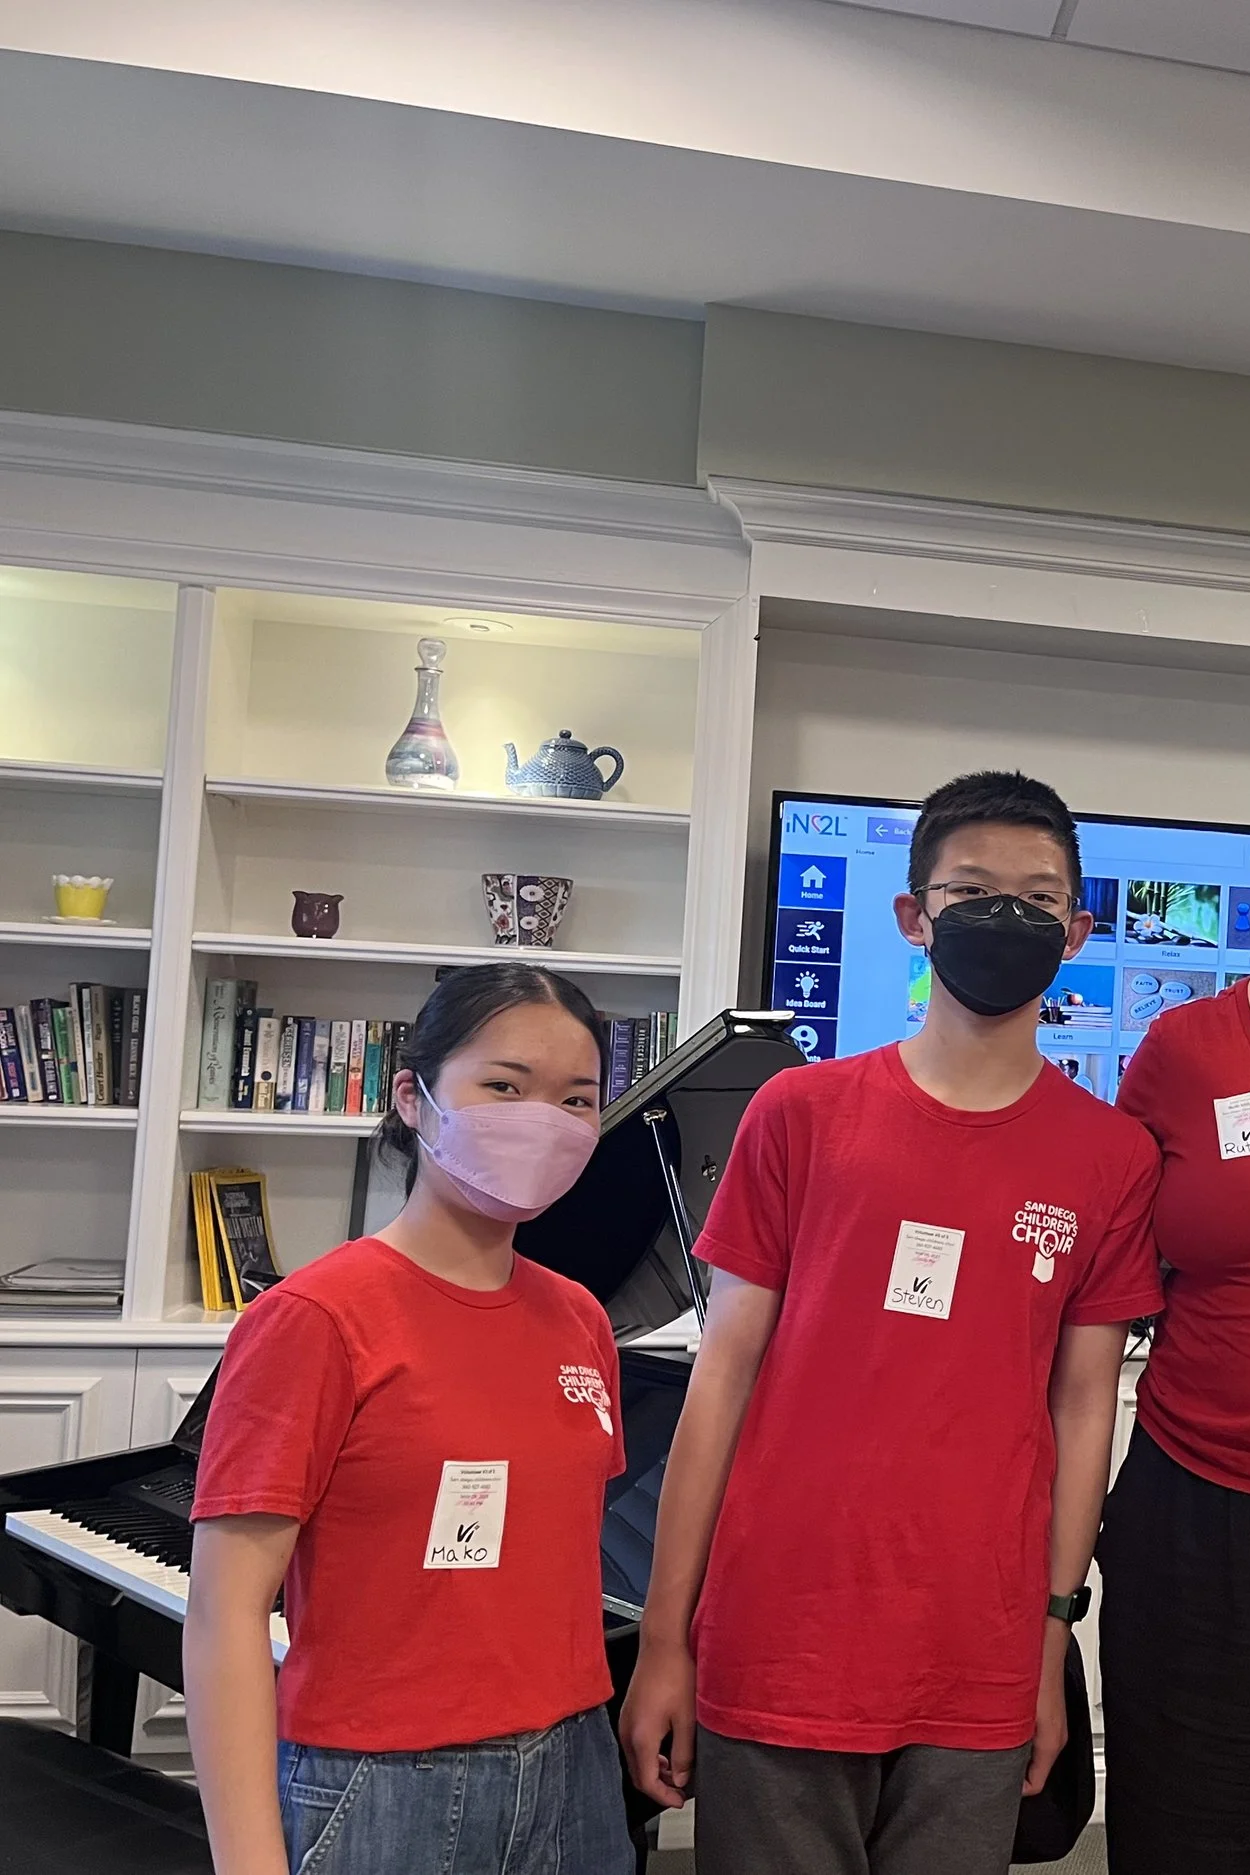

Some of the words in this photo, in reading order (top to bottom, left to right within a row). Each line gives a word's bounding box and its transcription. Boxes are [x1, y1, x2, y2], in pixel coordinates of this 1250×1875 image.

[801, 891, 824, 899] Home
[788, 944, 810, 954] Quick
[811, 945, 830, 955] Start
[1161, 950, 1181, 958] Relax
[785, 999, 803, 1008] Idea
[803, 999, 827, 1009] Board
[1134, 999, 1157, 1014] BELIEVE
[1053, 1033, 1074, 1041] Learn
[1024, 1200, 1047, 1214] SAN
[1047, 1205, 1076, 1222] DIEGO
[1014, 1210, 1078, 1238] CHILDREN'S
[1012, 1223, 1075, 1258] CHOIR
[892, 1287, 944, 1313] Steven
[560, 1364, 579, 1375] SAN
[431, 1545, 488, 1563] Mako
